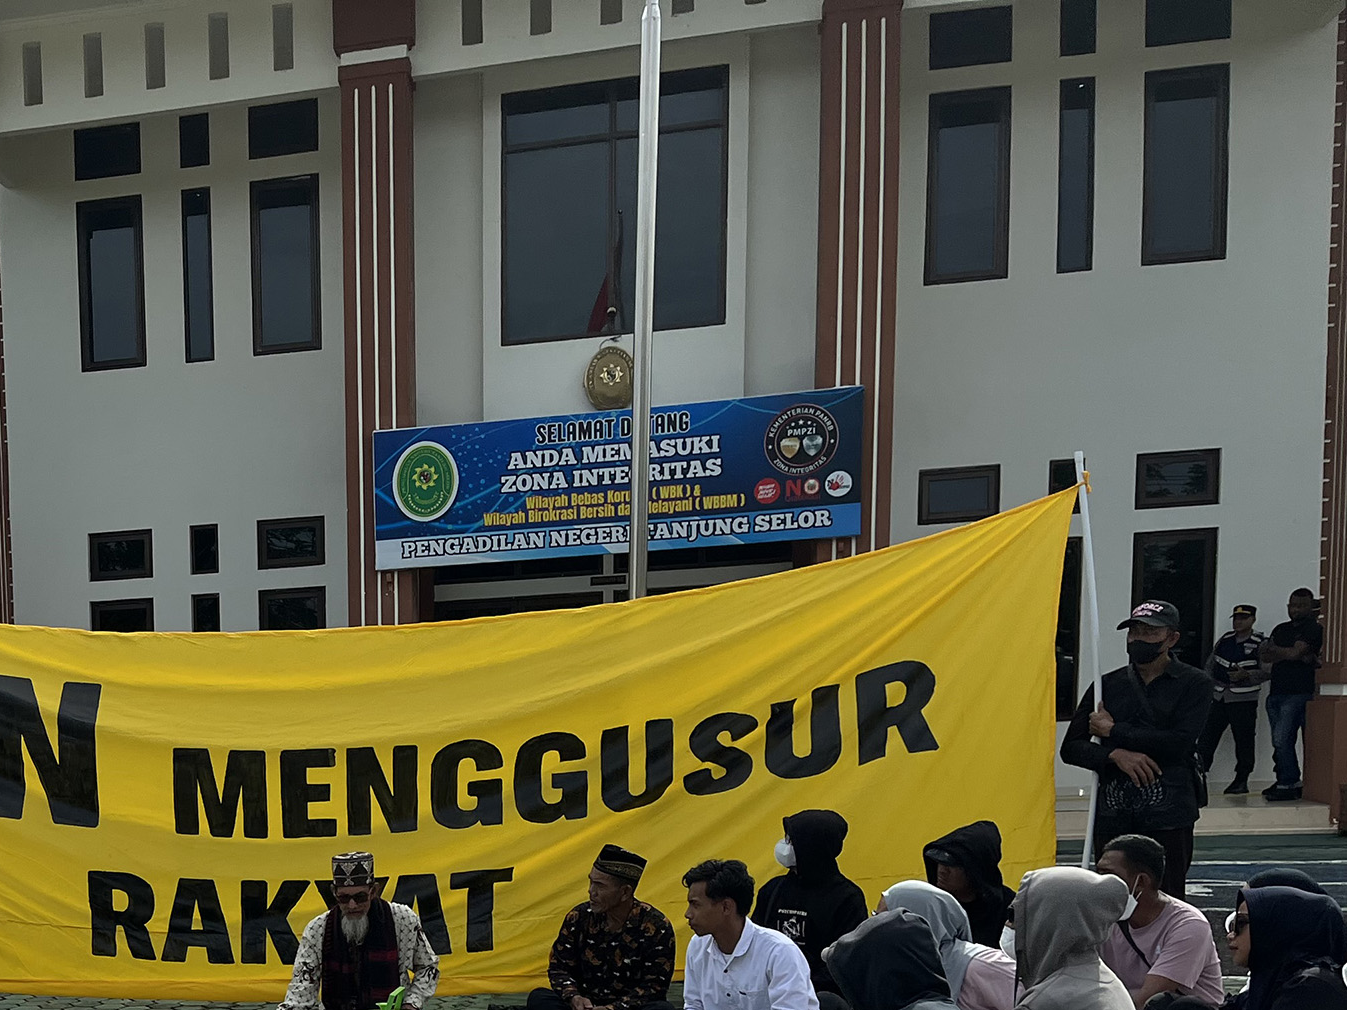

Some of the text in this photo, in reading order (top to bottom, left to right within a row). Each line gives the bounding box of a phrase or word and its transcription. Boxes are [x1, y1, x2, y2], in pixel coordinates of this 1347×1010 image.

[536, 411, 690, 445] SELAMAT DANG
[500, 458, 722, 493] ZONA INTERITAS
[507, 447, 578, 470] ANDA
[483, 511, 526, 526] Wilayah
[528, 507, 578, 522] Birokrasi
[580, 503, 615, 519] Bersih
[617, 502, 631, 516] da
[648, 497, 693, 514] elayani
[526, 494, 568, 511] Wilayah
[571, 492, 604, 506] Bebas
[607, 489, 631, 504] Koru
[402, 530, 545, 559] PENGADILAN
[754, 508, 832, 532] SELOR
[172, 659, 940, 839] MENGGUSUR
